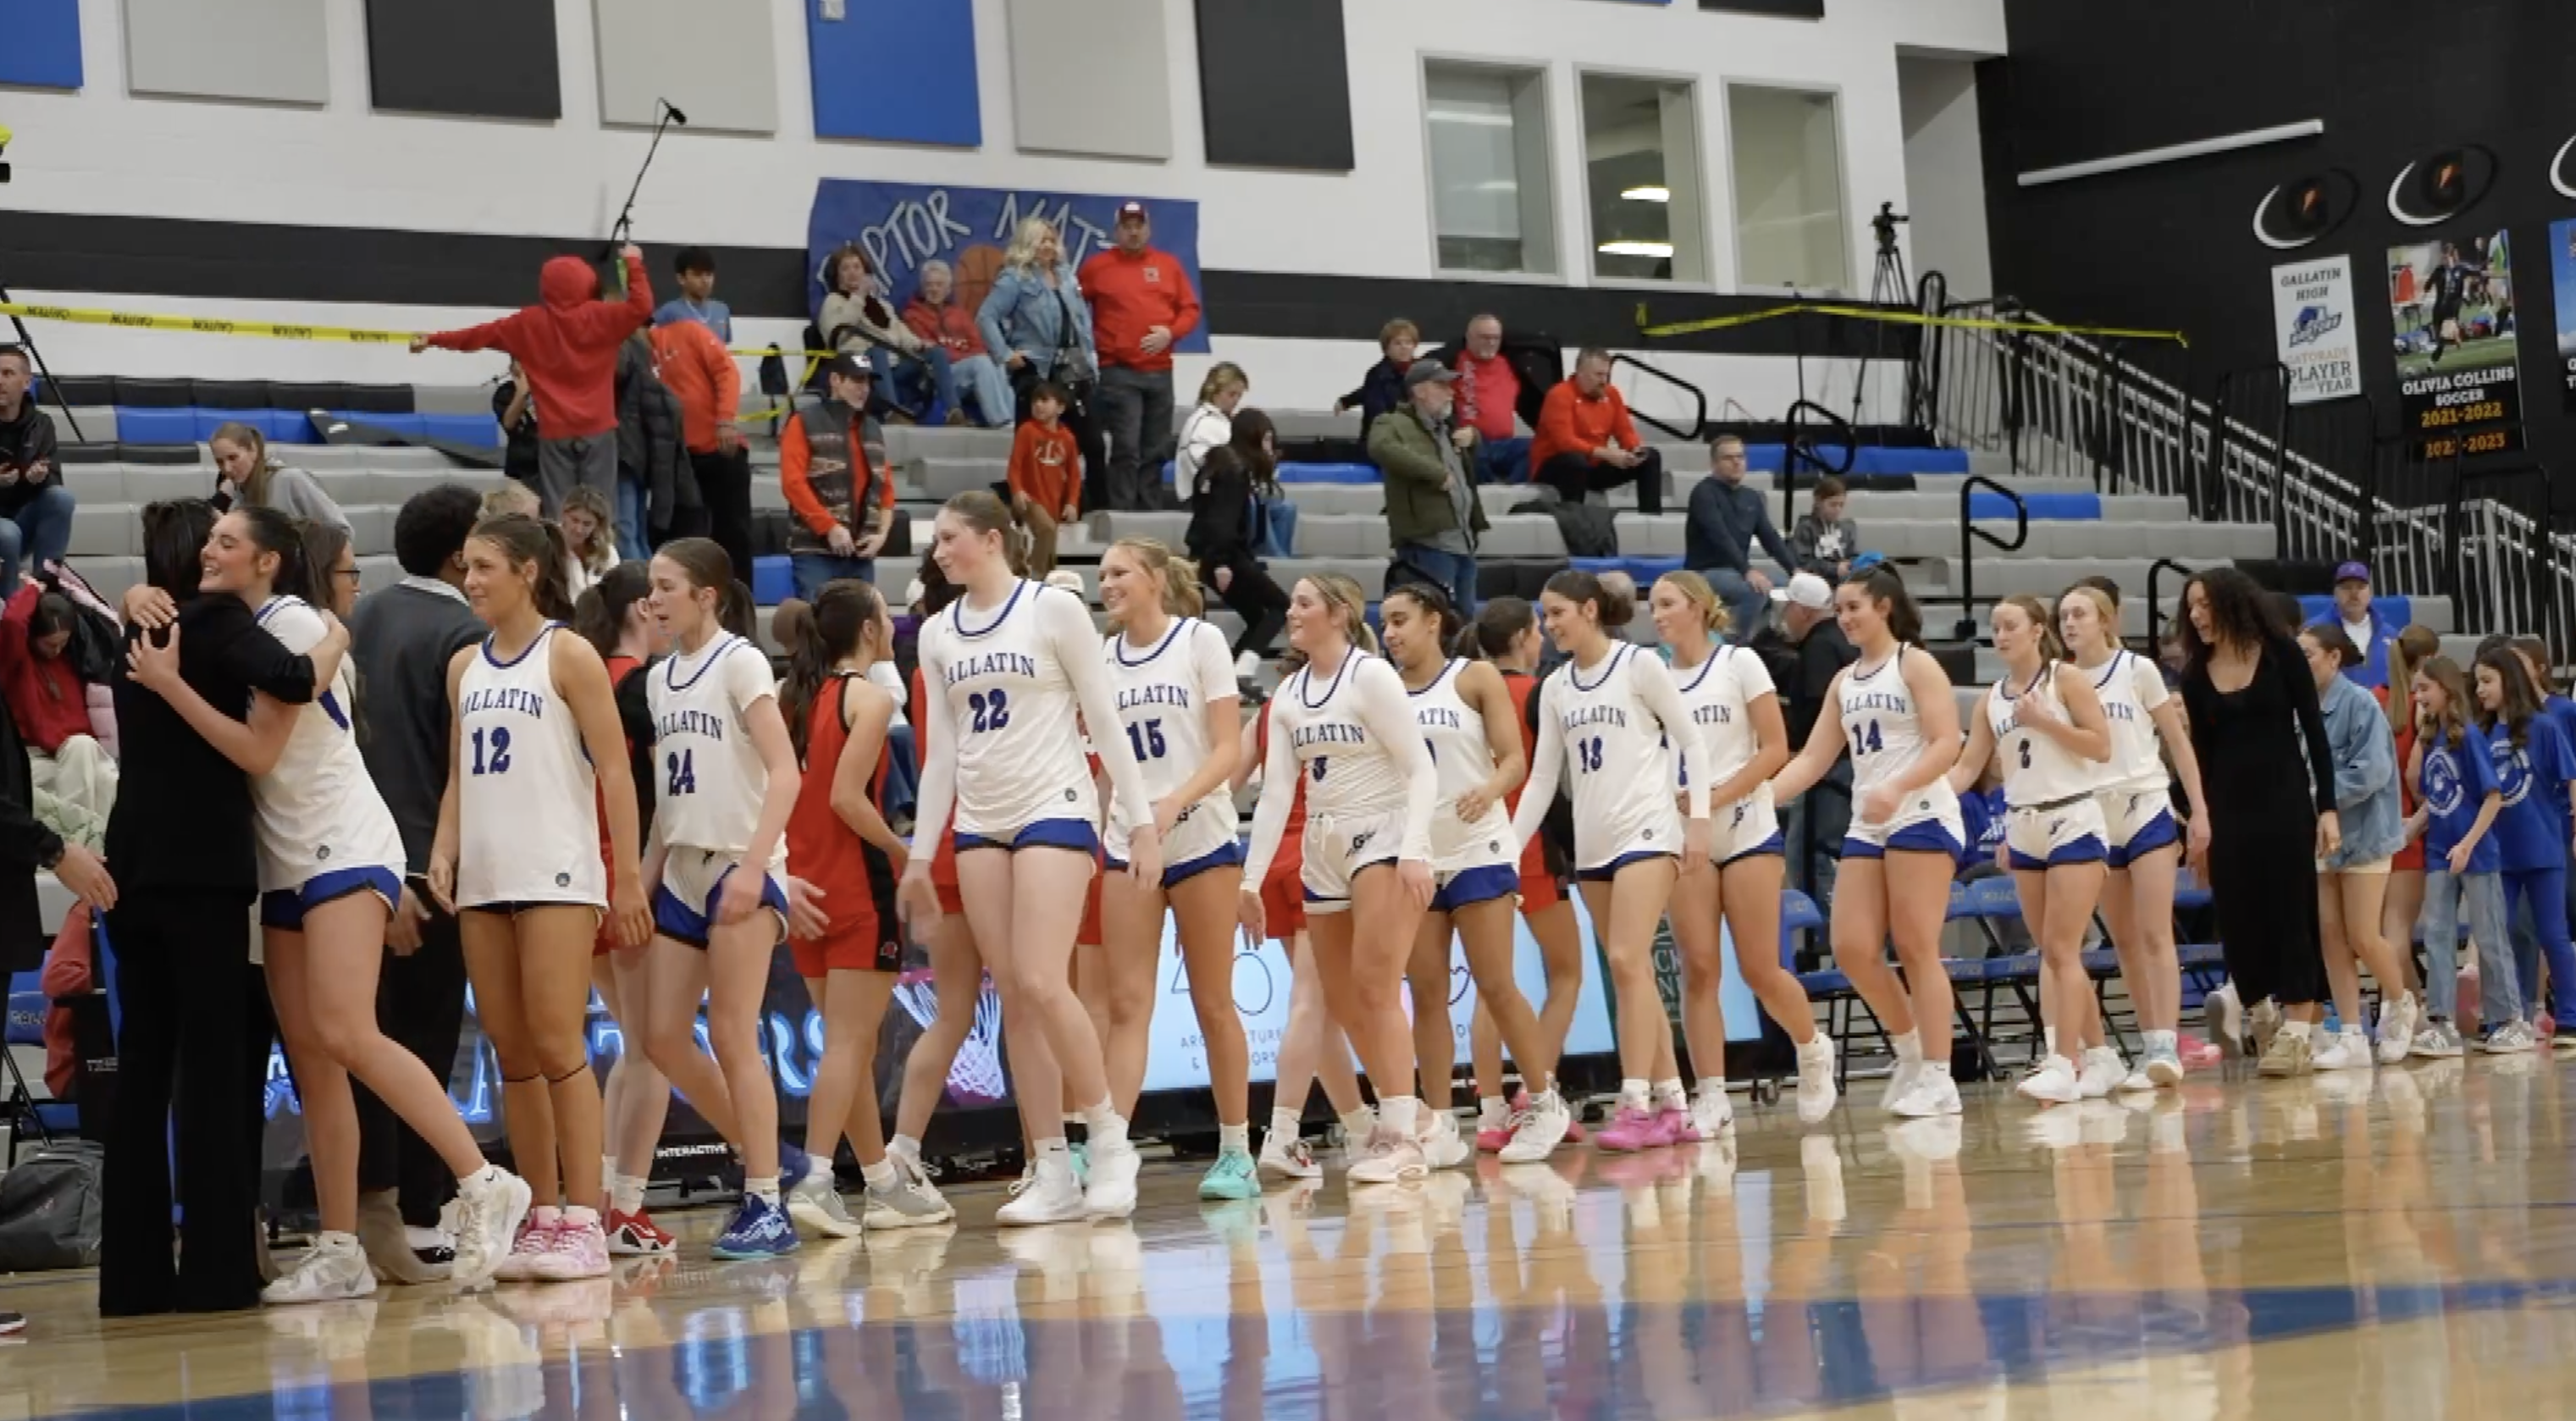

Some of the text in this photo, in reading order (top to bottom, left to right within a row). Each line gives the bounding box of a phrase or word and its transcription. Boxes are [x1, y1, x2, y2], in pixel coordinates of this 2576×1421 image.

[816, 190, 971, 298] PTOR
[2280, 268, 2341, 287] GALLATIN
[2296, 286, 2329, 301] HIGH
[2289, 361, 2352, 382] PLAYER
[2318, 378, 2353, 394] YEAR
[2402, 366, 2515, 395] OLIVIA COLLINS
[2435, 389, 2485, 406] SOCCER
[2421, 402, 2502, 428] 2021-2022
[969, 688, 1009, 733] 22
[472, 727, 511, 775] 12
[1126, 716, 1166, 762] 15
[1851, 718, 1883, 755] 14
[667, 749, 695, 797] 24
